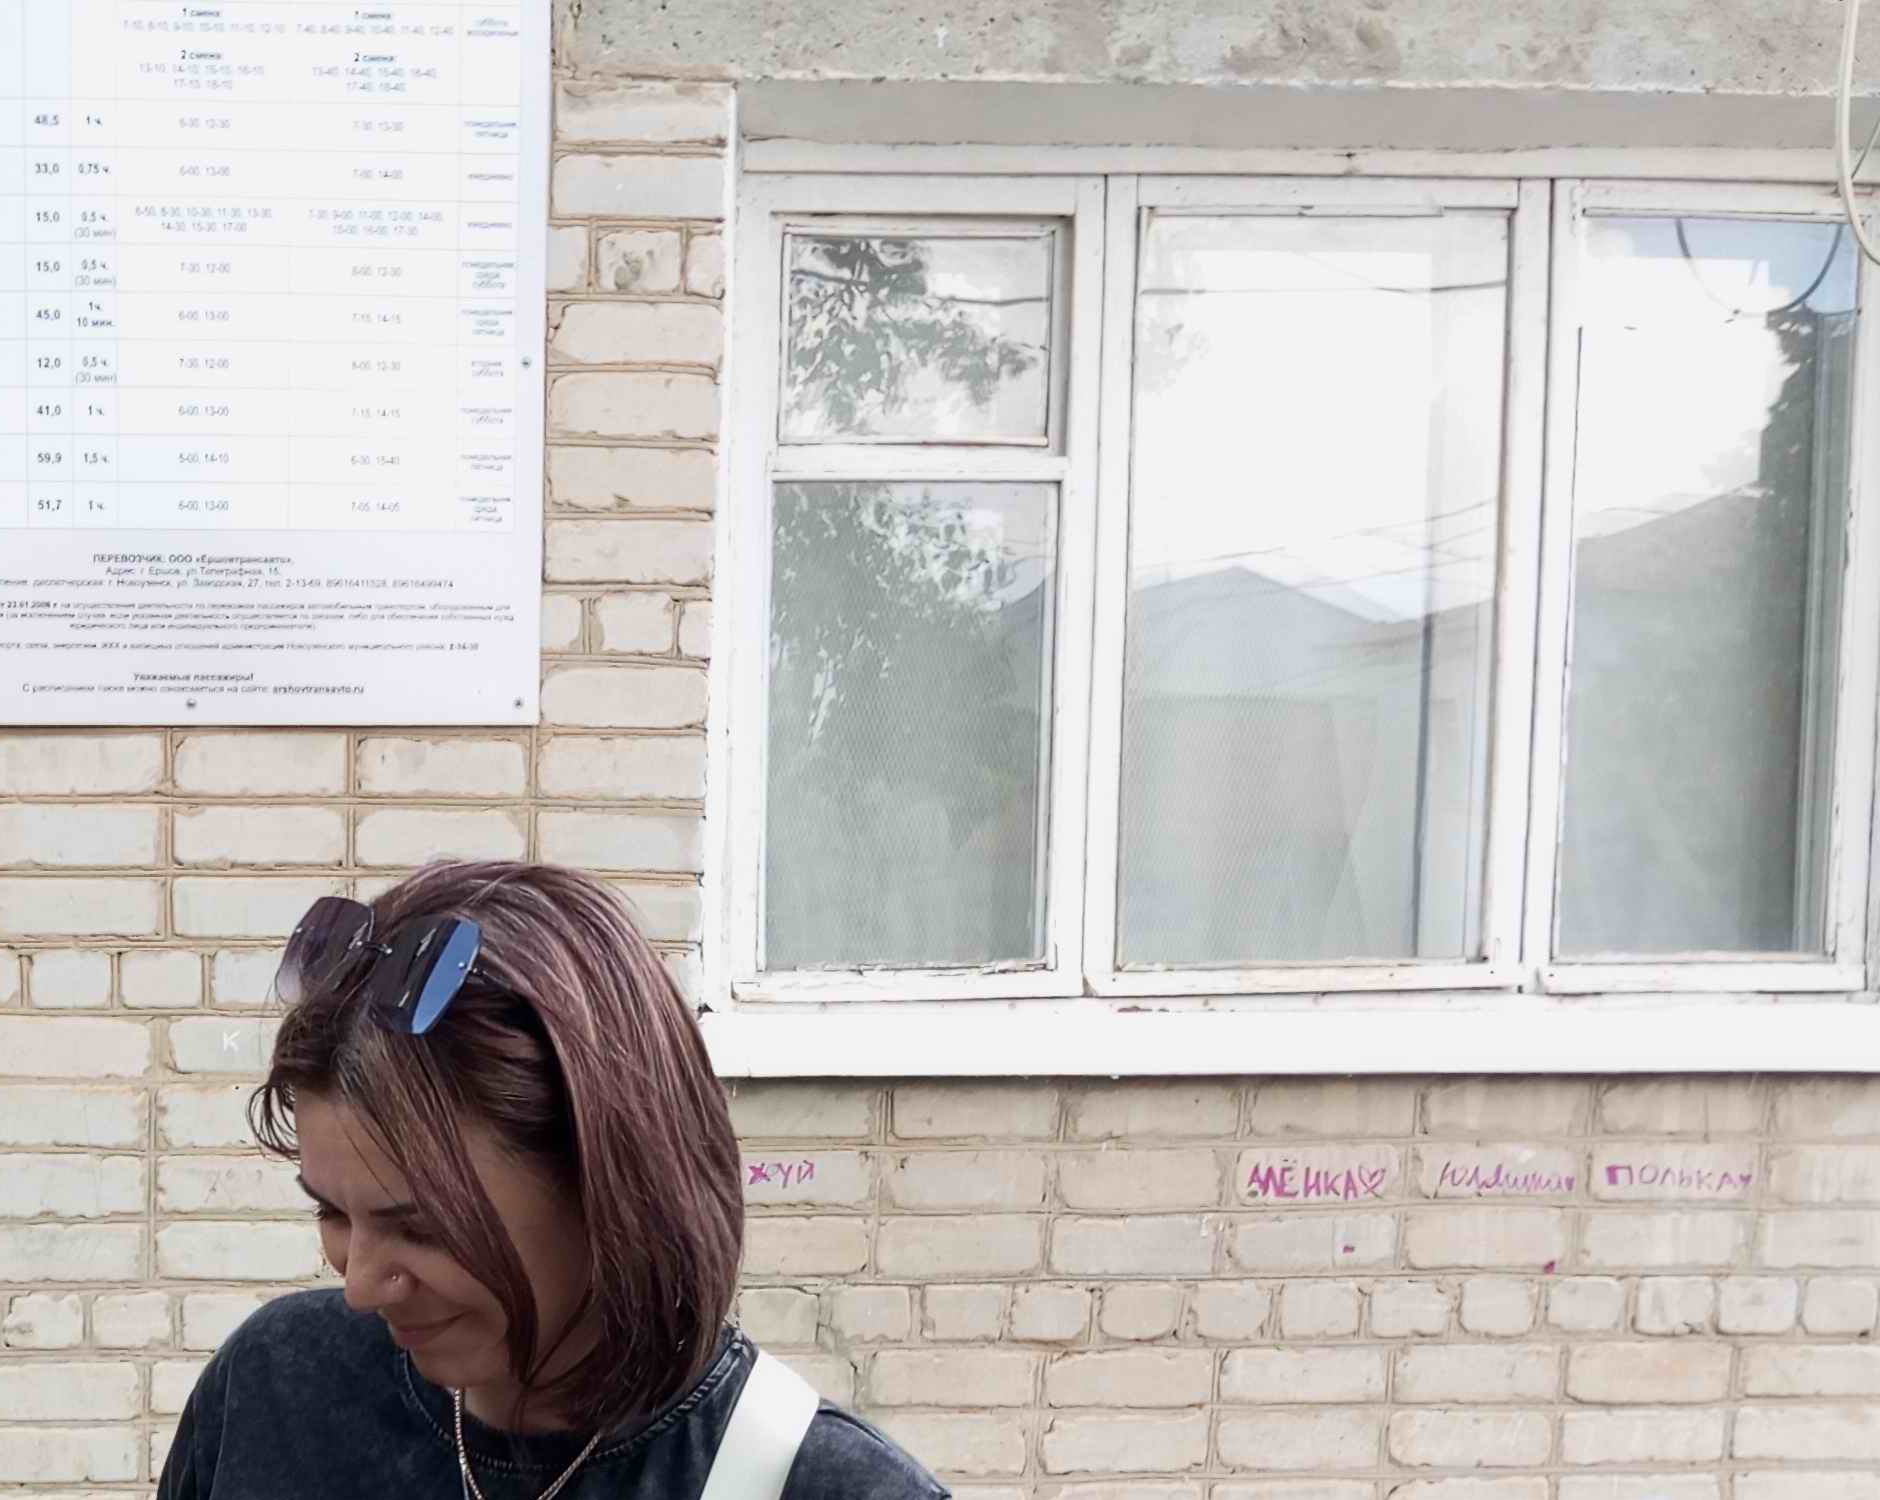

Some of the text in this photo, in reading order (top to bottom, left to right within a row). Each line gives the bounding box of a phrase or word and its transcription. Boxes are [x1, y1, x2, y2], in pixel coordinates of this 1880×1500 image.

[35, 115, 59, 125] 48,5
[35, 163, 59, 174] 33,0
[36, 211, 60, 222] 15,0
[37, 261, 60, 272] 15,0
[36, 309, 60, 320] 45,0
[77, 317, 88, 327] 10
[38, 357, 61, 368] 12,0
[37, 405, 61, 416] 41,0
[38, 452, 62, 464] 59,9
[38, 500, 62, 511] 51,7
[168, 554, 192, 563] ООО
